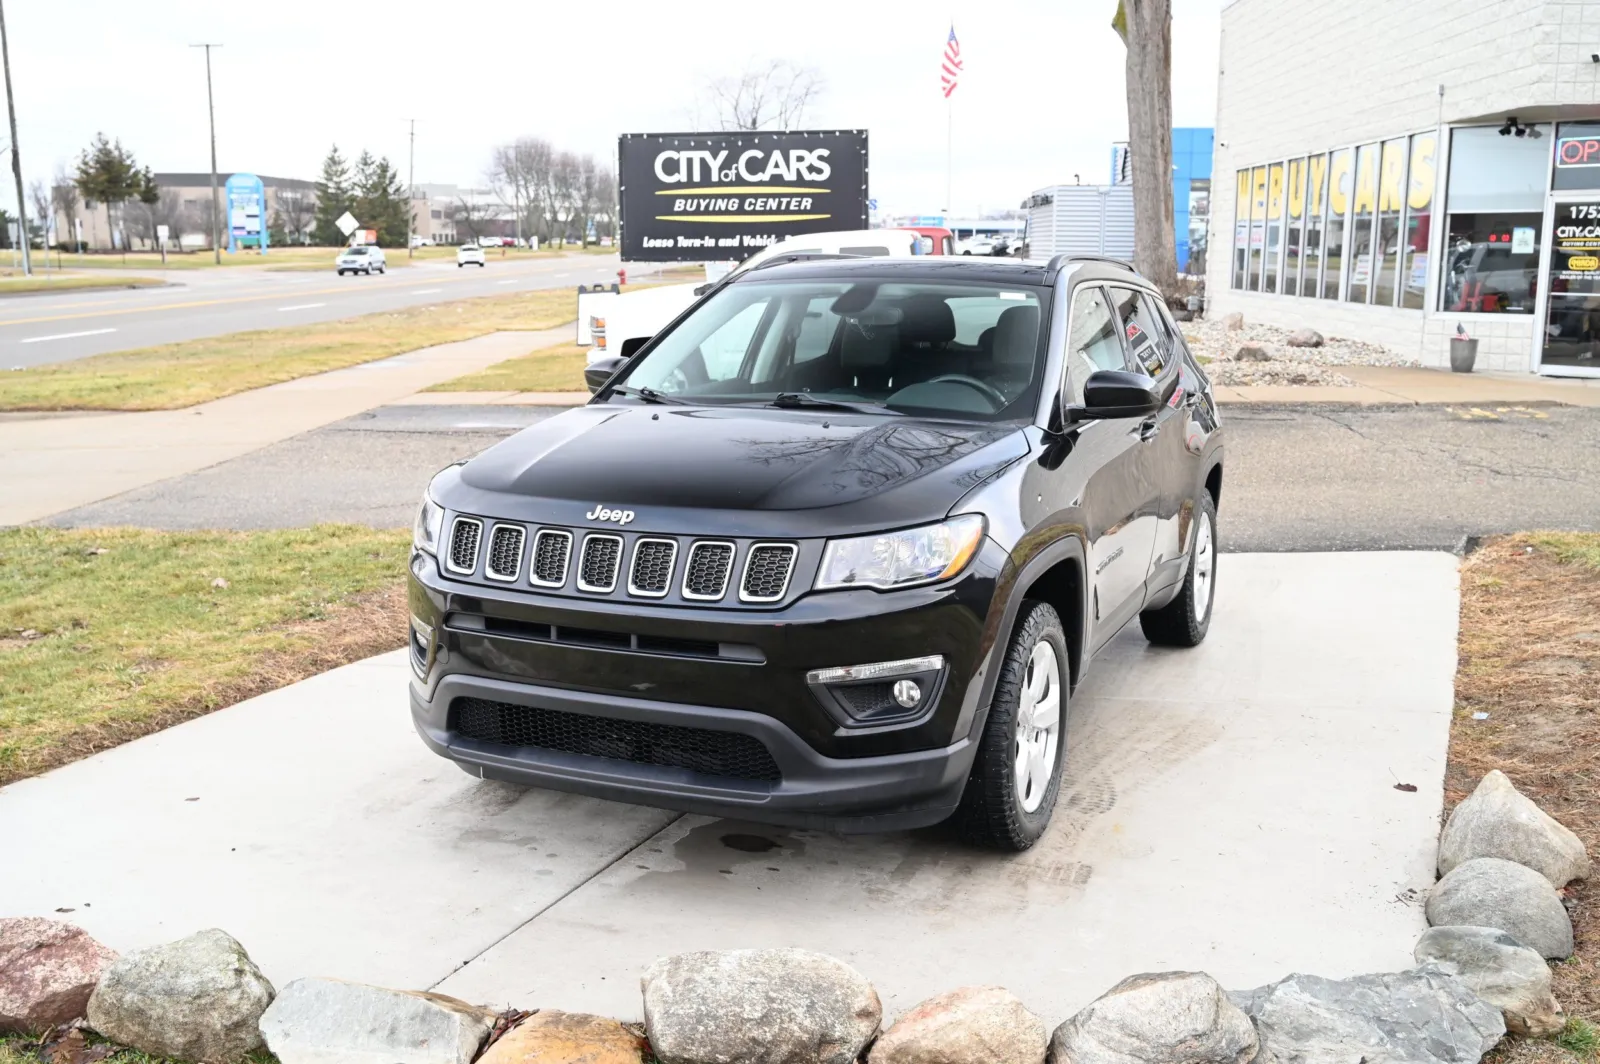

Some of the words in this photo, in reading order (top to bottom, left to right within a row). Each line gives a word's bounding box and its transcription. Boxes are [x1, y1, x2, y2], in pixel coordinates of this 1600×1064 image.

[1562, 141, 1600, 163] OP
[654, 150, 729, 183] CITY
[720, 164, 738, 182] of
[737, 148, 832, 182] CARS
[1268, 157, 1326, 221] BUY
[1329, 137, 1436, 217] CARS
[674, 198, 740, 212] BUYING
[744, 197, 813, 211] CENTER
[642, 236, 675, 248] Lease
[718, 235, 741, 247] and
[1557, 226, 1583, 238] CITY
[1584, 226, 1600, 238] CA
[586, 504, 635, 525] Jeep
